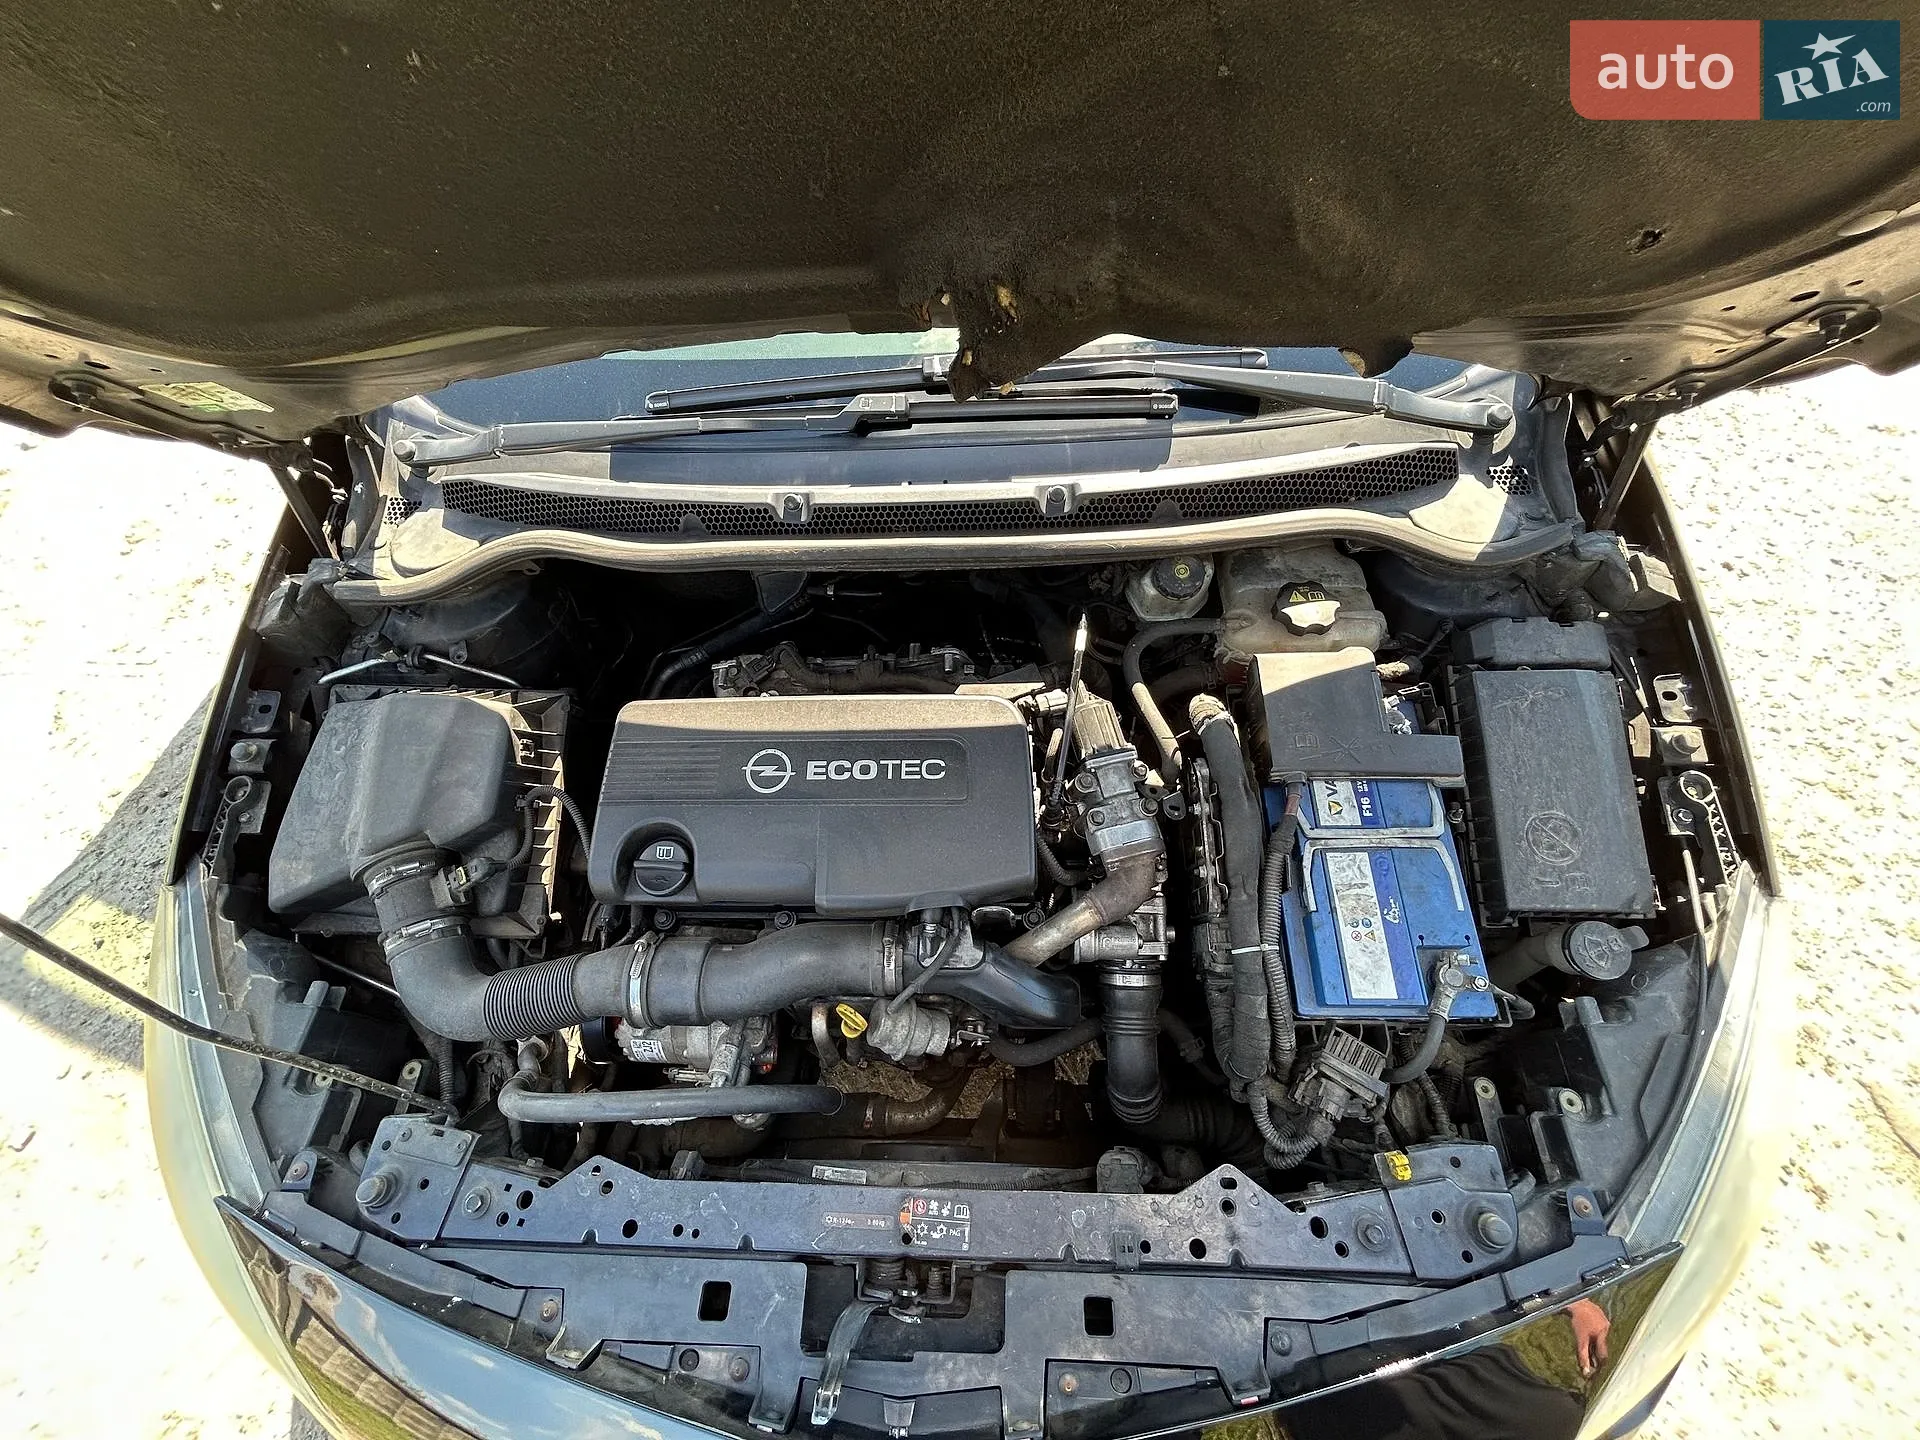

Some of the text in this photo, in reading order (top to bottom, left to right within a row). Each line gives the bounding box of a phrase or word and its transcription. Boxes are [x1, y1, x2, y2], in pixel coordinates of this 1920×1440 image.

[806, 759, 947, 780] ECOTEC
[1360, 797, 1374, 817] F16
[949, 1228, 961, 1237] PAG
